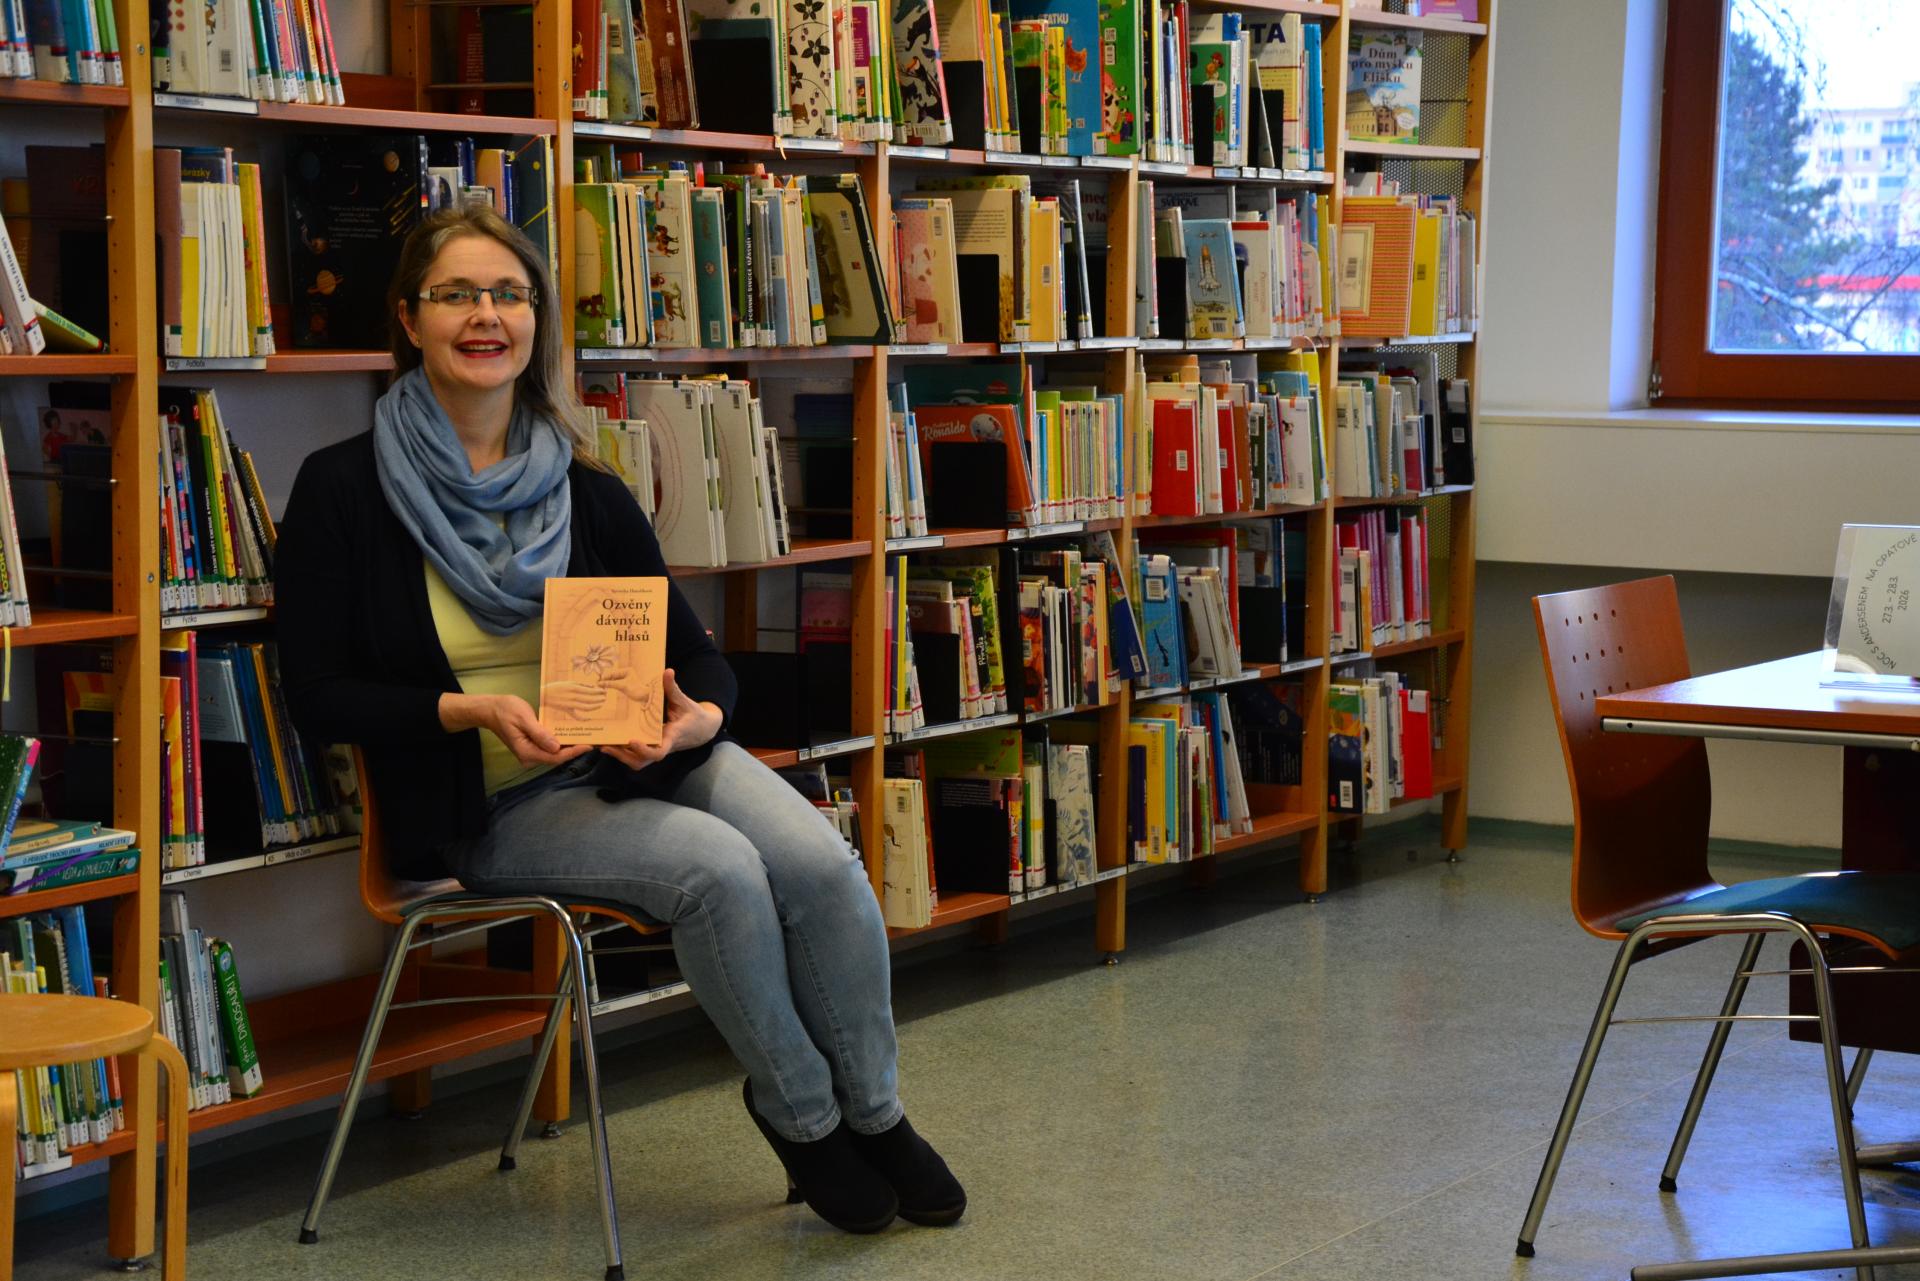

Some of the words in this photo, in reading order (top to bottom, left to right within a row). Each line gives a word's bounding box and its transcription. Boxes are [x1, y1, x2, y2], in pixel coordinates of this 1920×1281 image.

[1368, 47, 1397, 59] Dům
[1351, 60, 1372, 71] pro
[1363, 70, 1401, 82] Elišku
[922, 420, 966, 441] Ronaldo
[1865, 568, 1878, 582] NA
[602, 598, 651, 614] Ozvěny
[1897, 589, 1910, 611] 2026
[596, 613, 651, 630] dávných
[615, 629, 650, 642] hlasů
